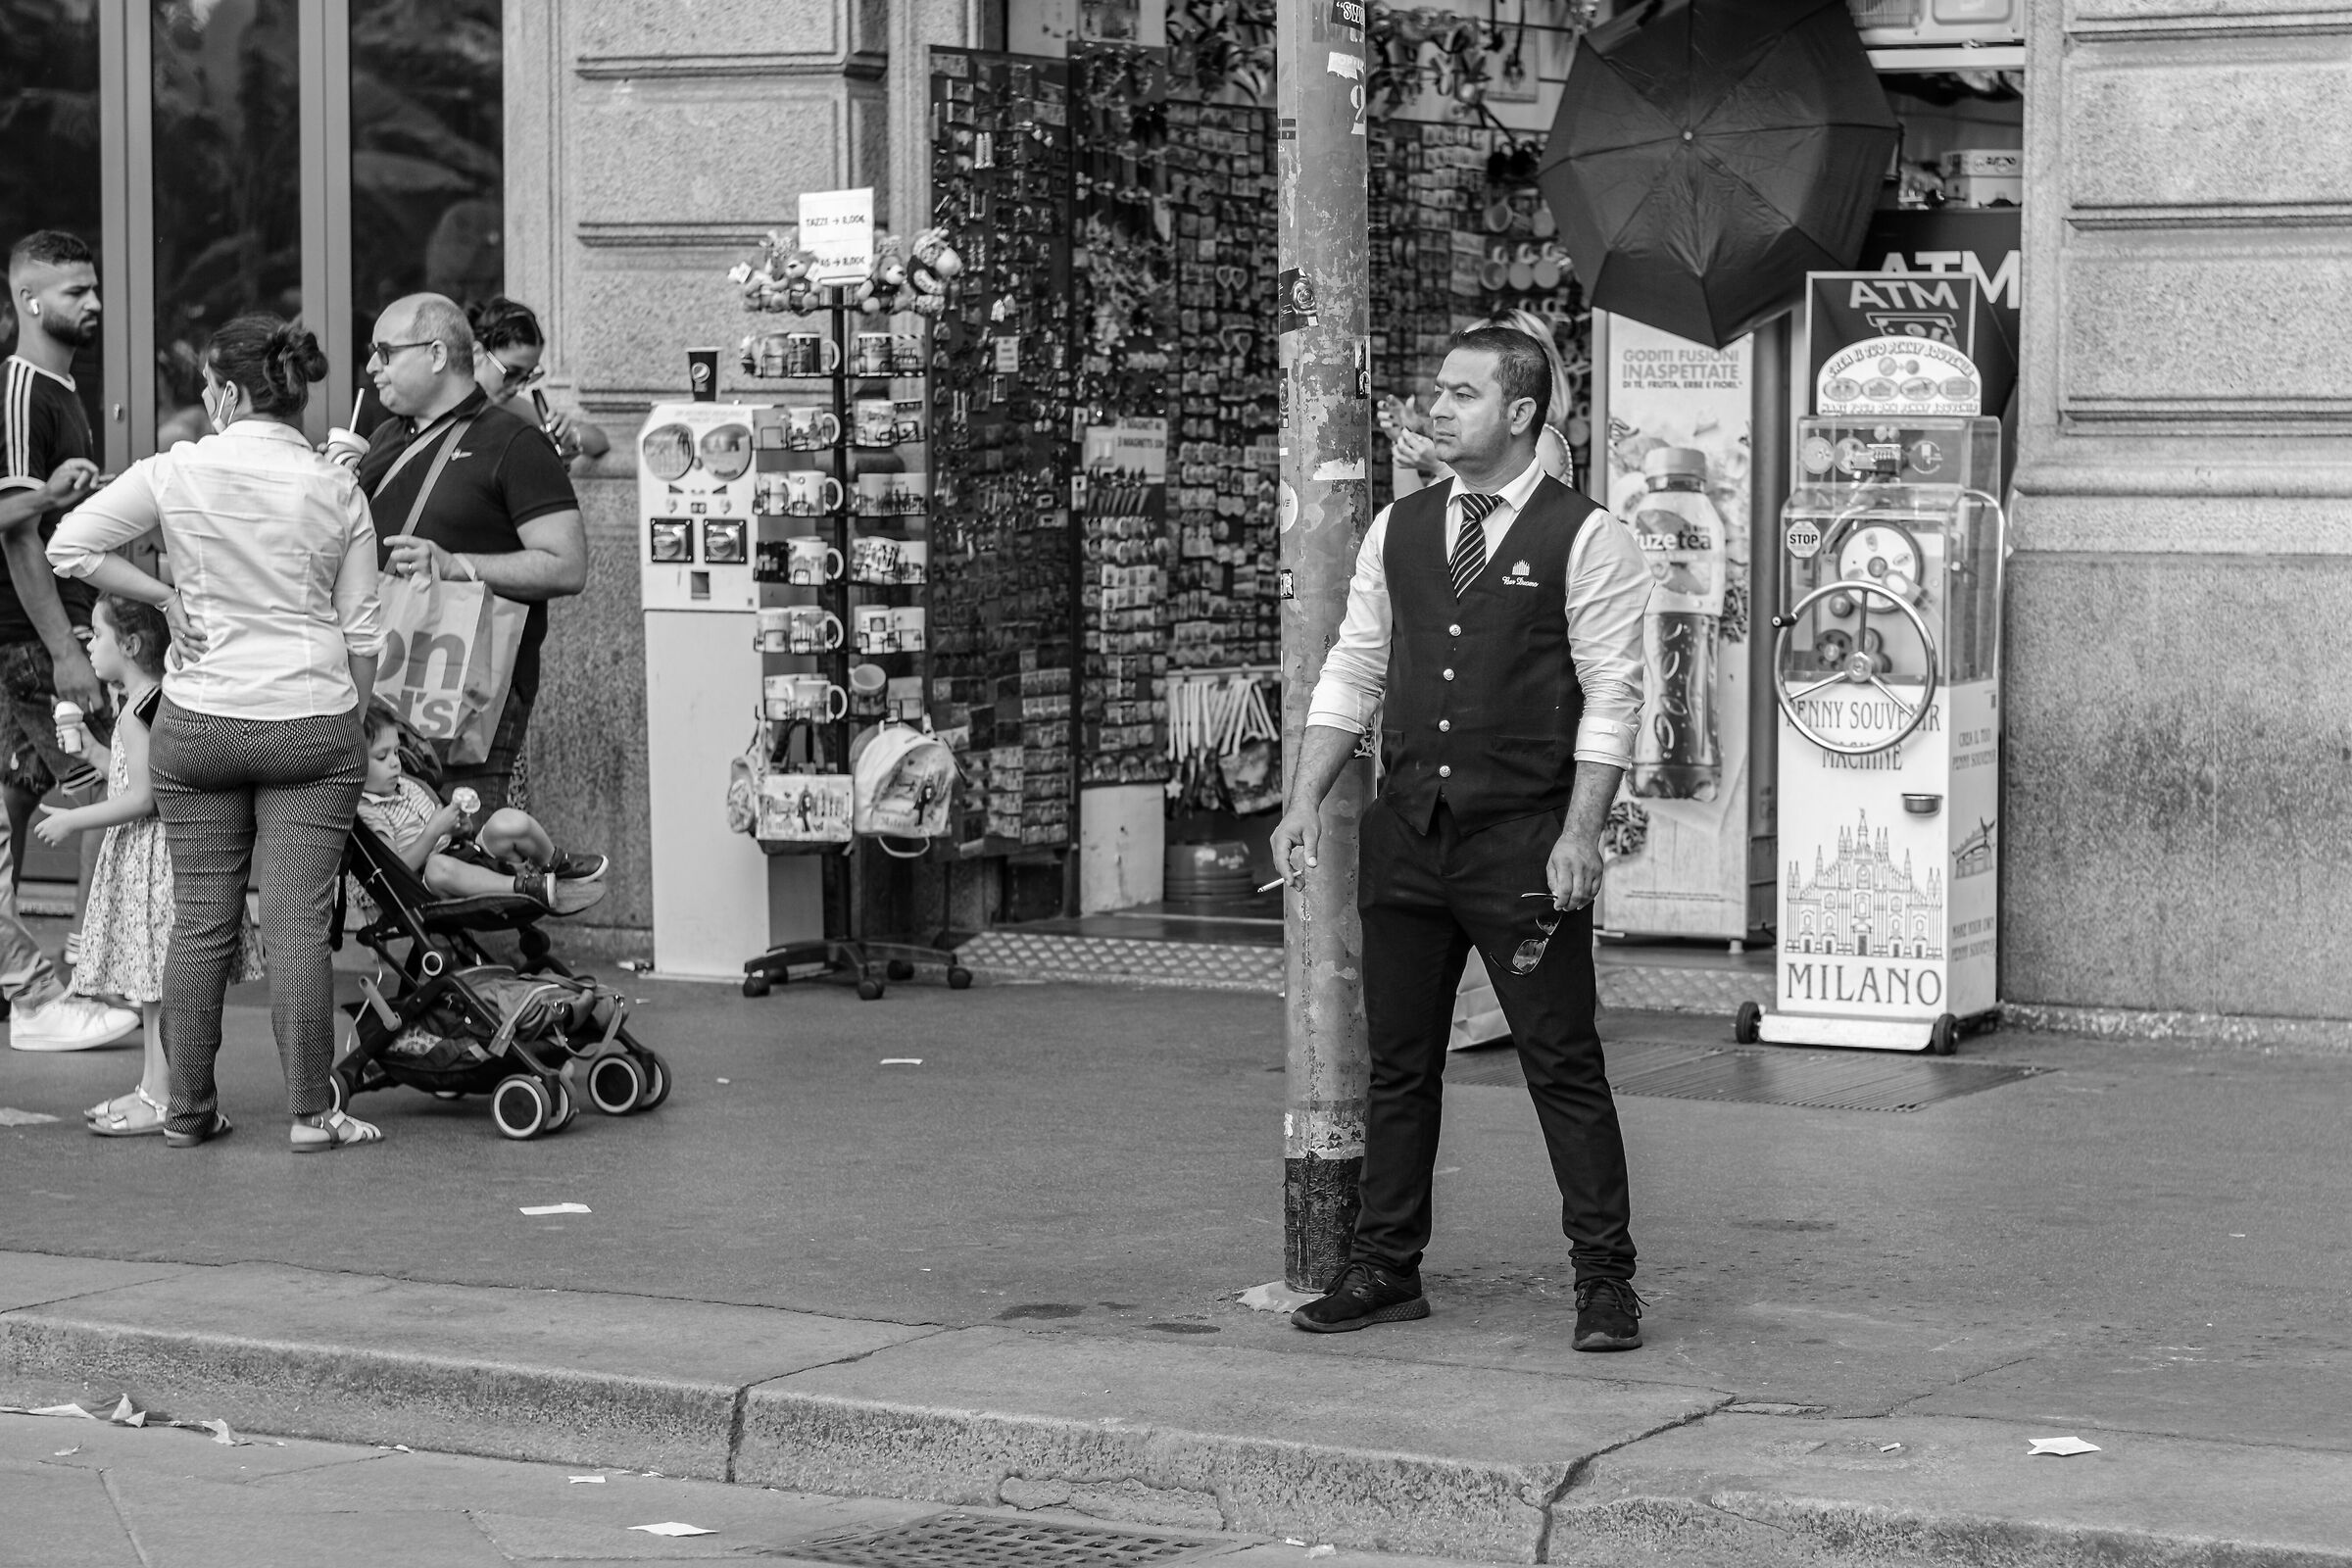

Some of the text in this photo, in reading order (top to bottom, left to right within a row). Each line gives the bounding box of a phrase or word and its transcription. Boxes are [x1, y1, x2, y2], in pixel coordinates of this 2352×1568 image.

[1849, 280, 1960, 310] ATM
[1623, 349, 1740, 363] GODITI FUSIONI
[1622, 364, 1740, 379] INASPETTATE
[1789, 533, 1818, 545] STOP
[1785, 961, 1943, 1006] MILANO
